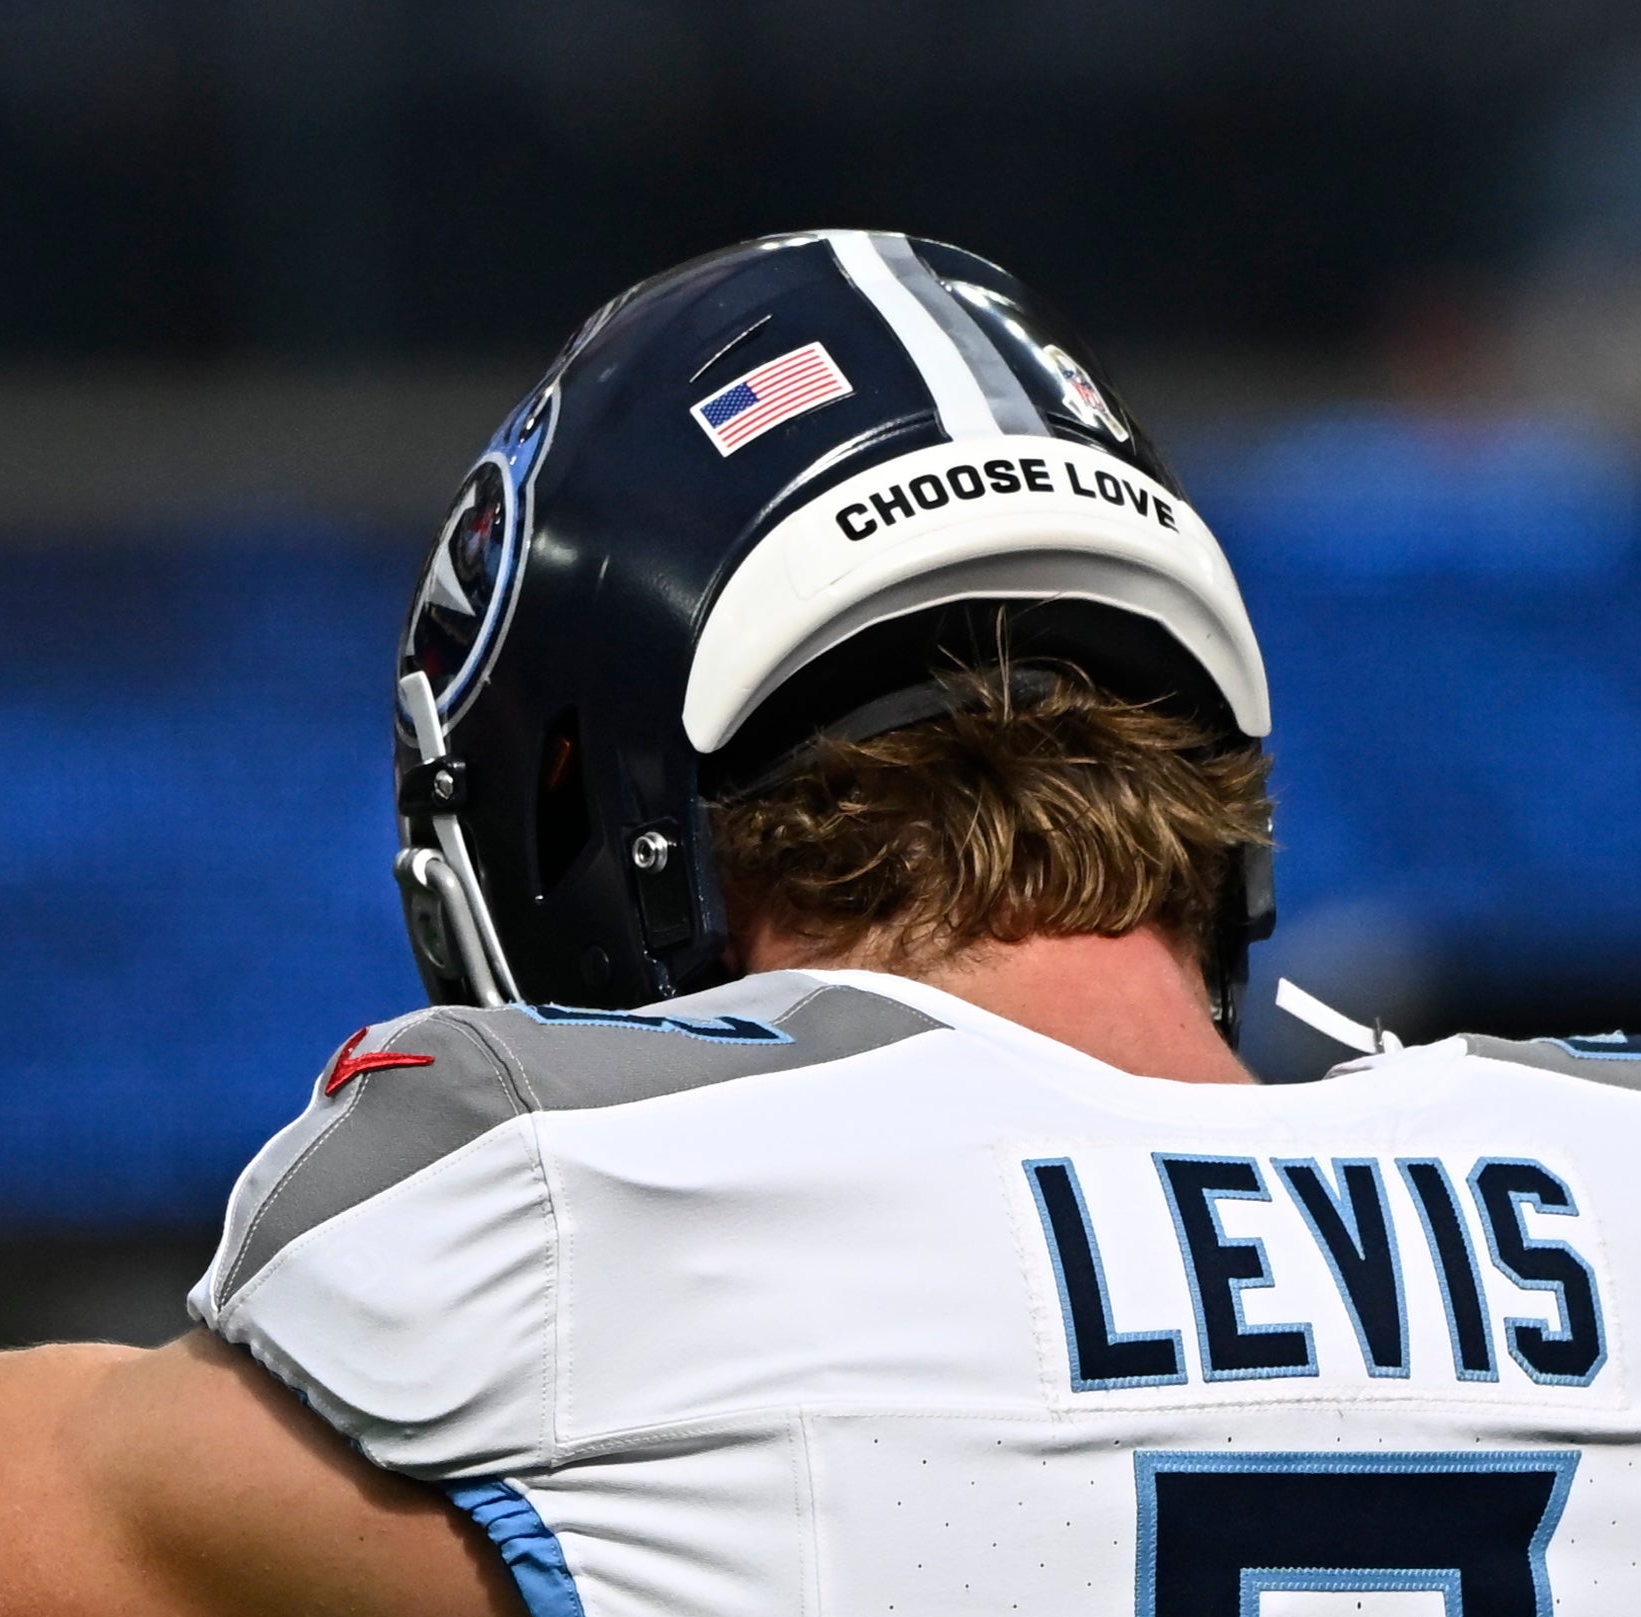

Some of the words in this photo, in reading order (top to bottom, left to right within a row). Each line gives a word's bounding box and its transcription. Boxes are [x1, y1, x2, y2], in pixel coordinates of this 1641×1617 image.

[835, 458, 1054, 541] CHOOSE
[1064, 461, 1179, 533] LOVE
[1021, 1152, 1609, 1393] LEVIS
